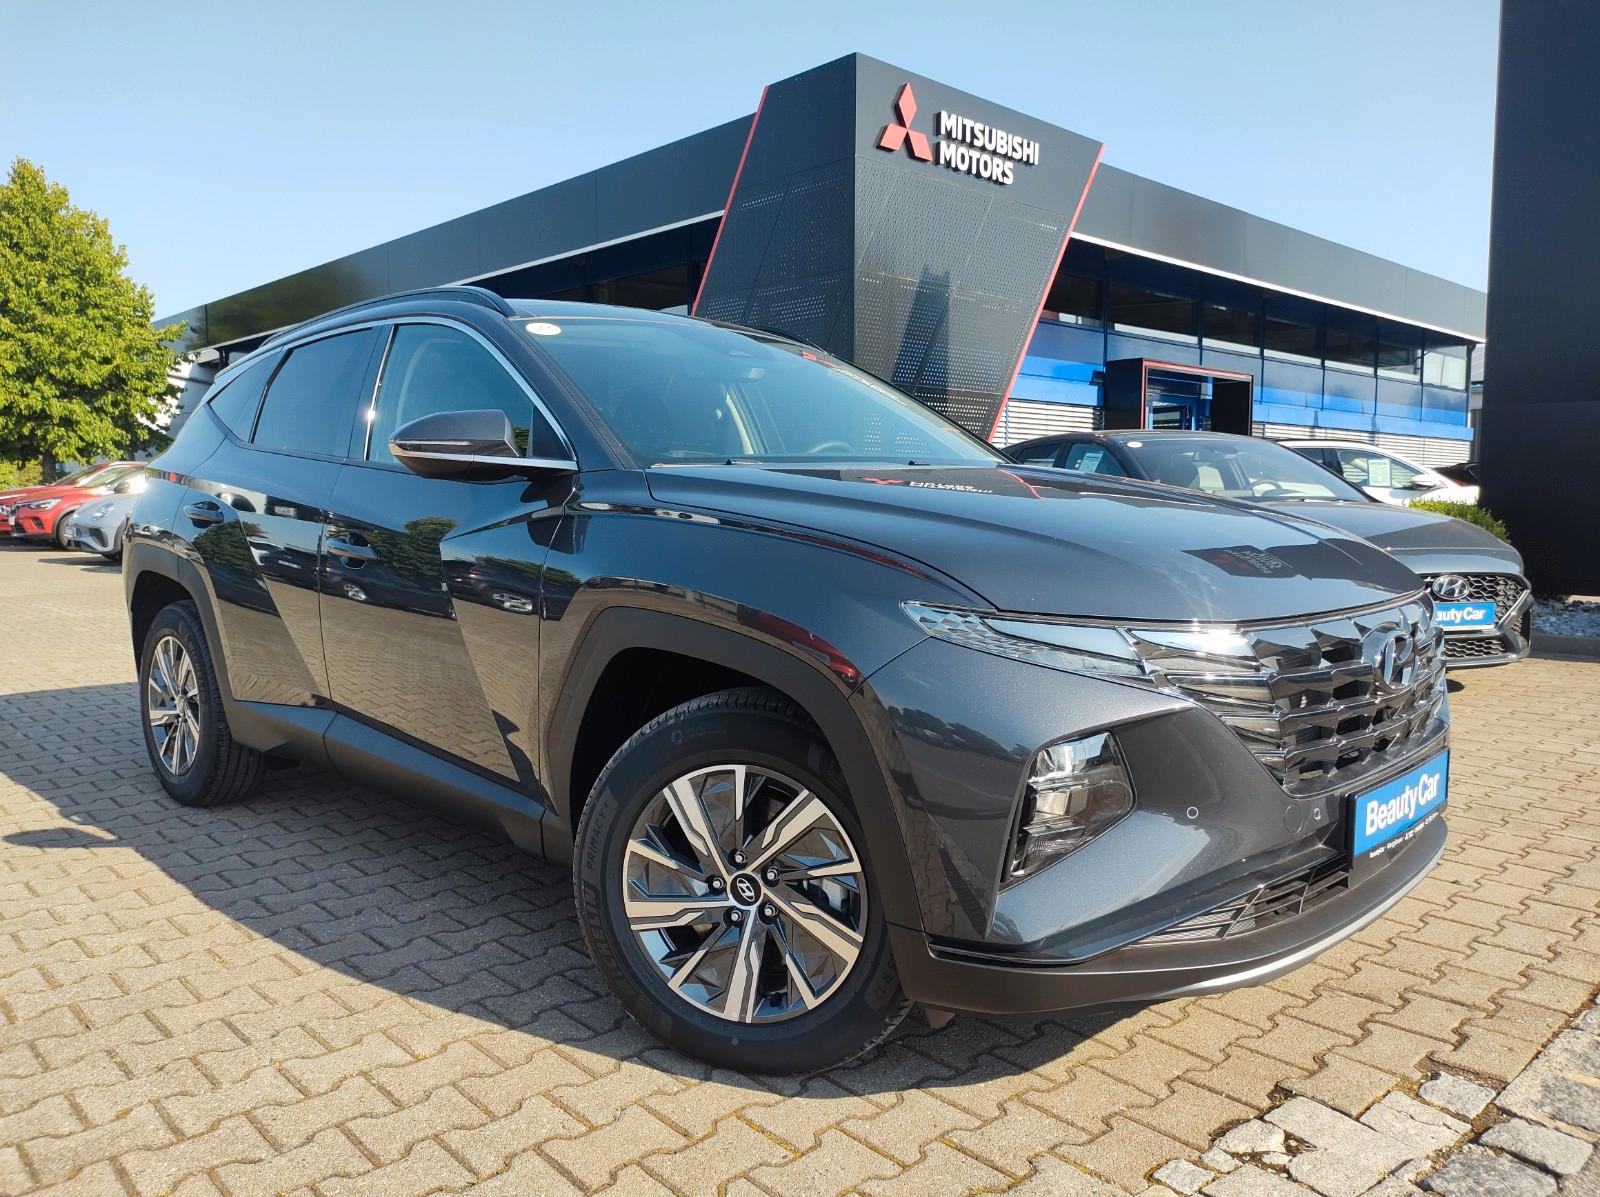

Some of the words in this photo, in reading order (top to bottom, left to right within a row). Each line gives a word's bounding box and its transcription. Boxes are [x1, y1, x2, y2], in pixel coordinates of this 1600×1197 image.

[940, 109, 1040, 166] MITSUBISHI
[939, 140, 1014, 185] MOTORS
[1435, 607, 1486, 624] autyCar
